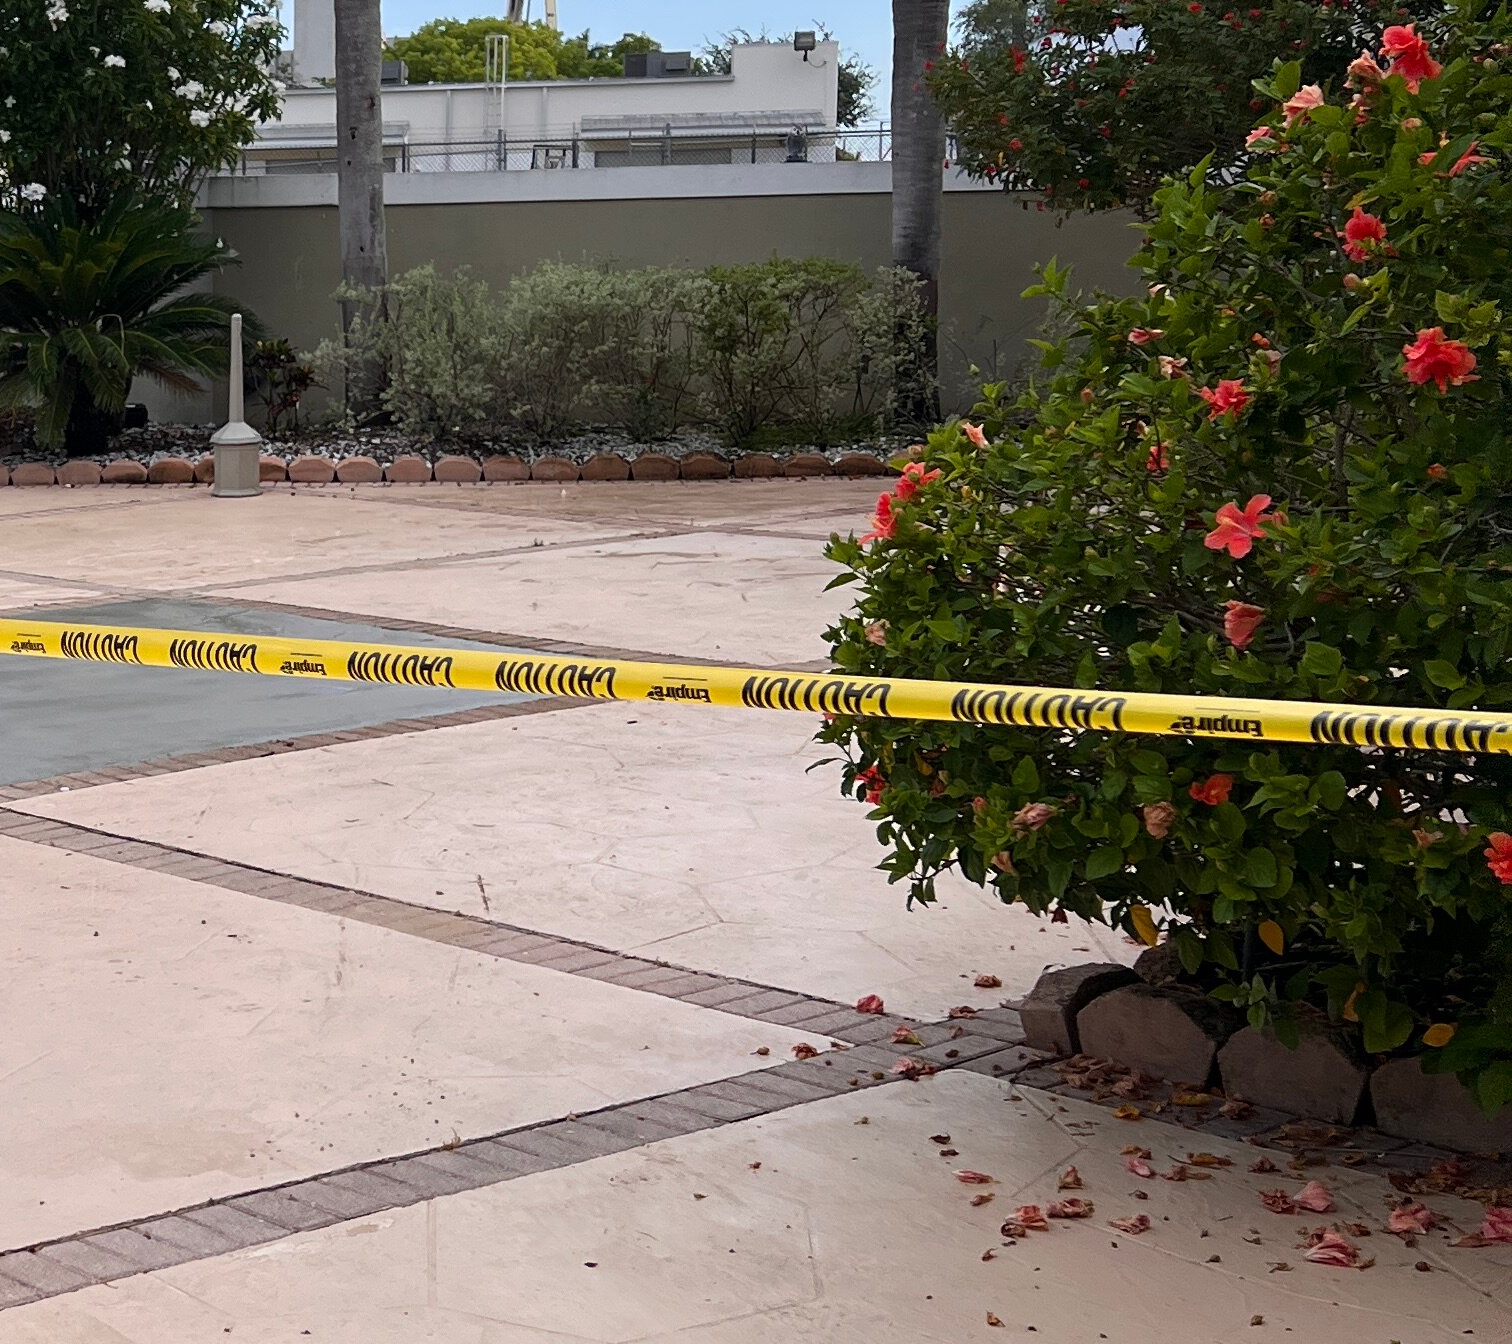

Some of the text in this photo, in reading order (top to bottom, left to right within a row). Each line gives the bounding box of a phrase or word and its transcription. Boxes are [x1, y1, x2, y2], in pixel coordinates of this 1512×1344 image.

[11, 640, 48, 654] Empire
[61, 630, 143, 666] CAUTION
[169, 638, 261, 674] CAUTION
[281, 659, 328, 676] Empire
[348, 650, 456, 689] CAUTION
[495, 660, 617, 700] CAUTION
[647, 685, 713, 704] Empire
[742, 676, 892, 716] CAUTION
[950, 687, 1127, 732] CAUTION
[1170, 715, 1264, 737] Empire
